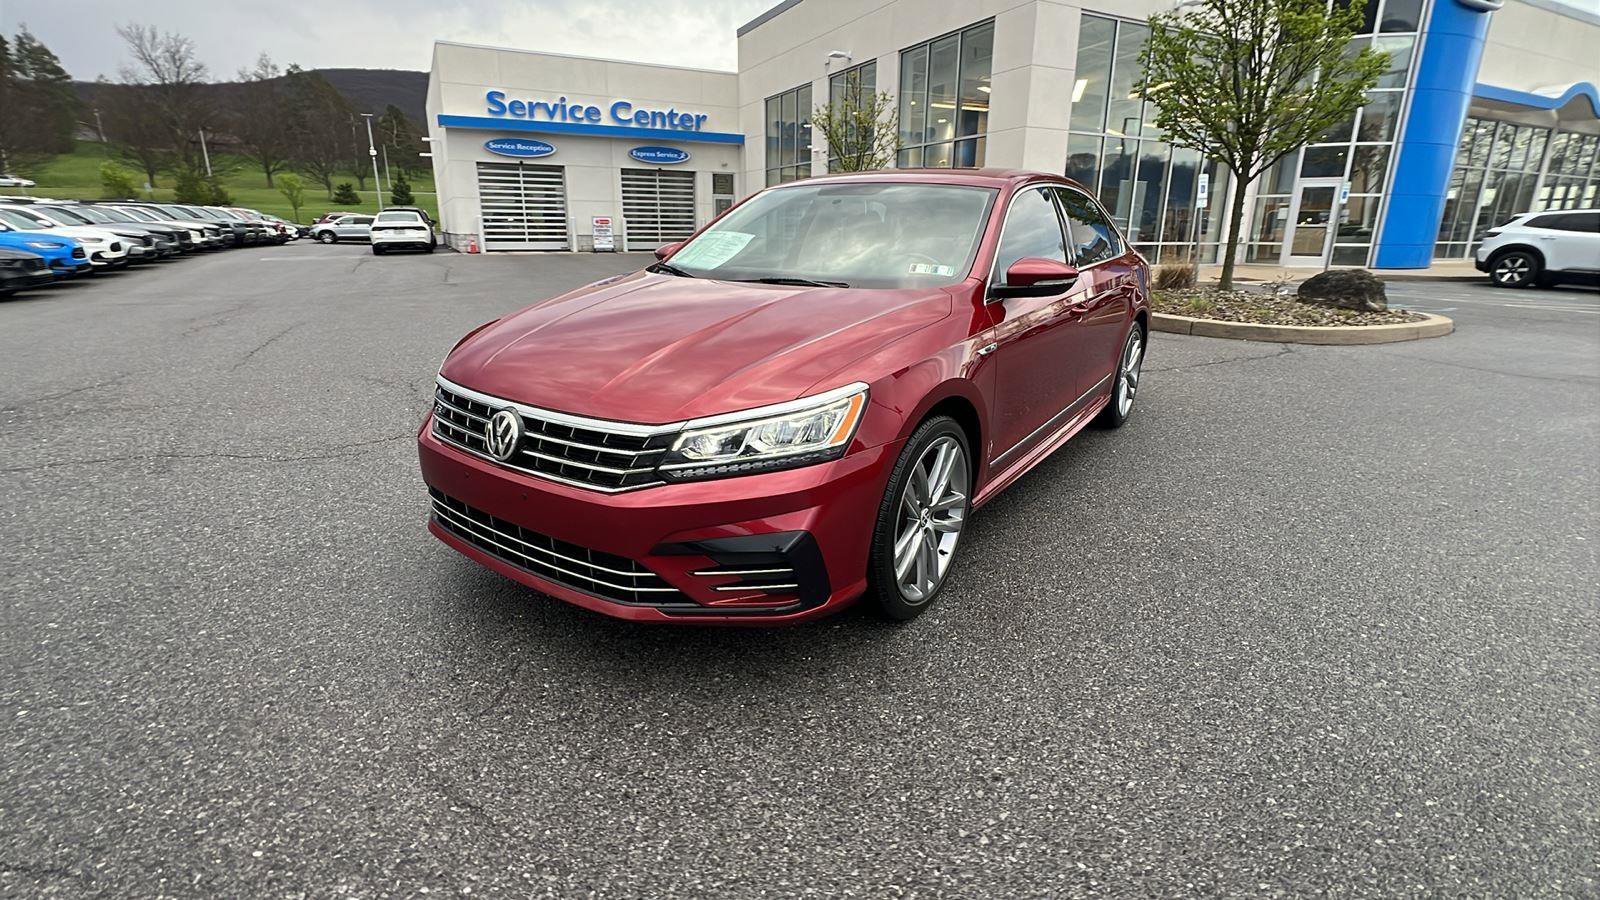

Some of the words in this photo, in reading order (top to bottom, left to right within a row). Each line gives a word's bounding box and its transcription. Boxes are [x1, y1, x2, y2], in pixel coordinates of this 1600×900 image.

[486, 90, 601, 123] Service
[610, 101, 708, 131] Center
[489, 142, 515, 150] Service
[516, 143, 552, 153] Reception
[632, 150, 656, 159] Express
[656, 151, 679, 159] Service
